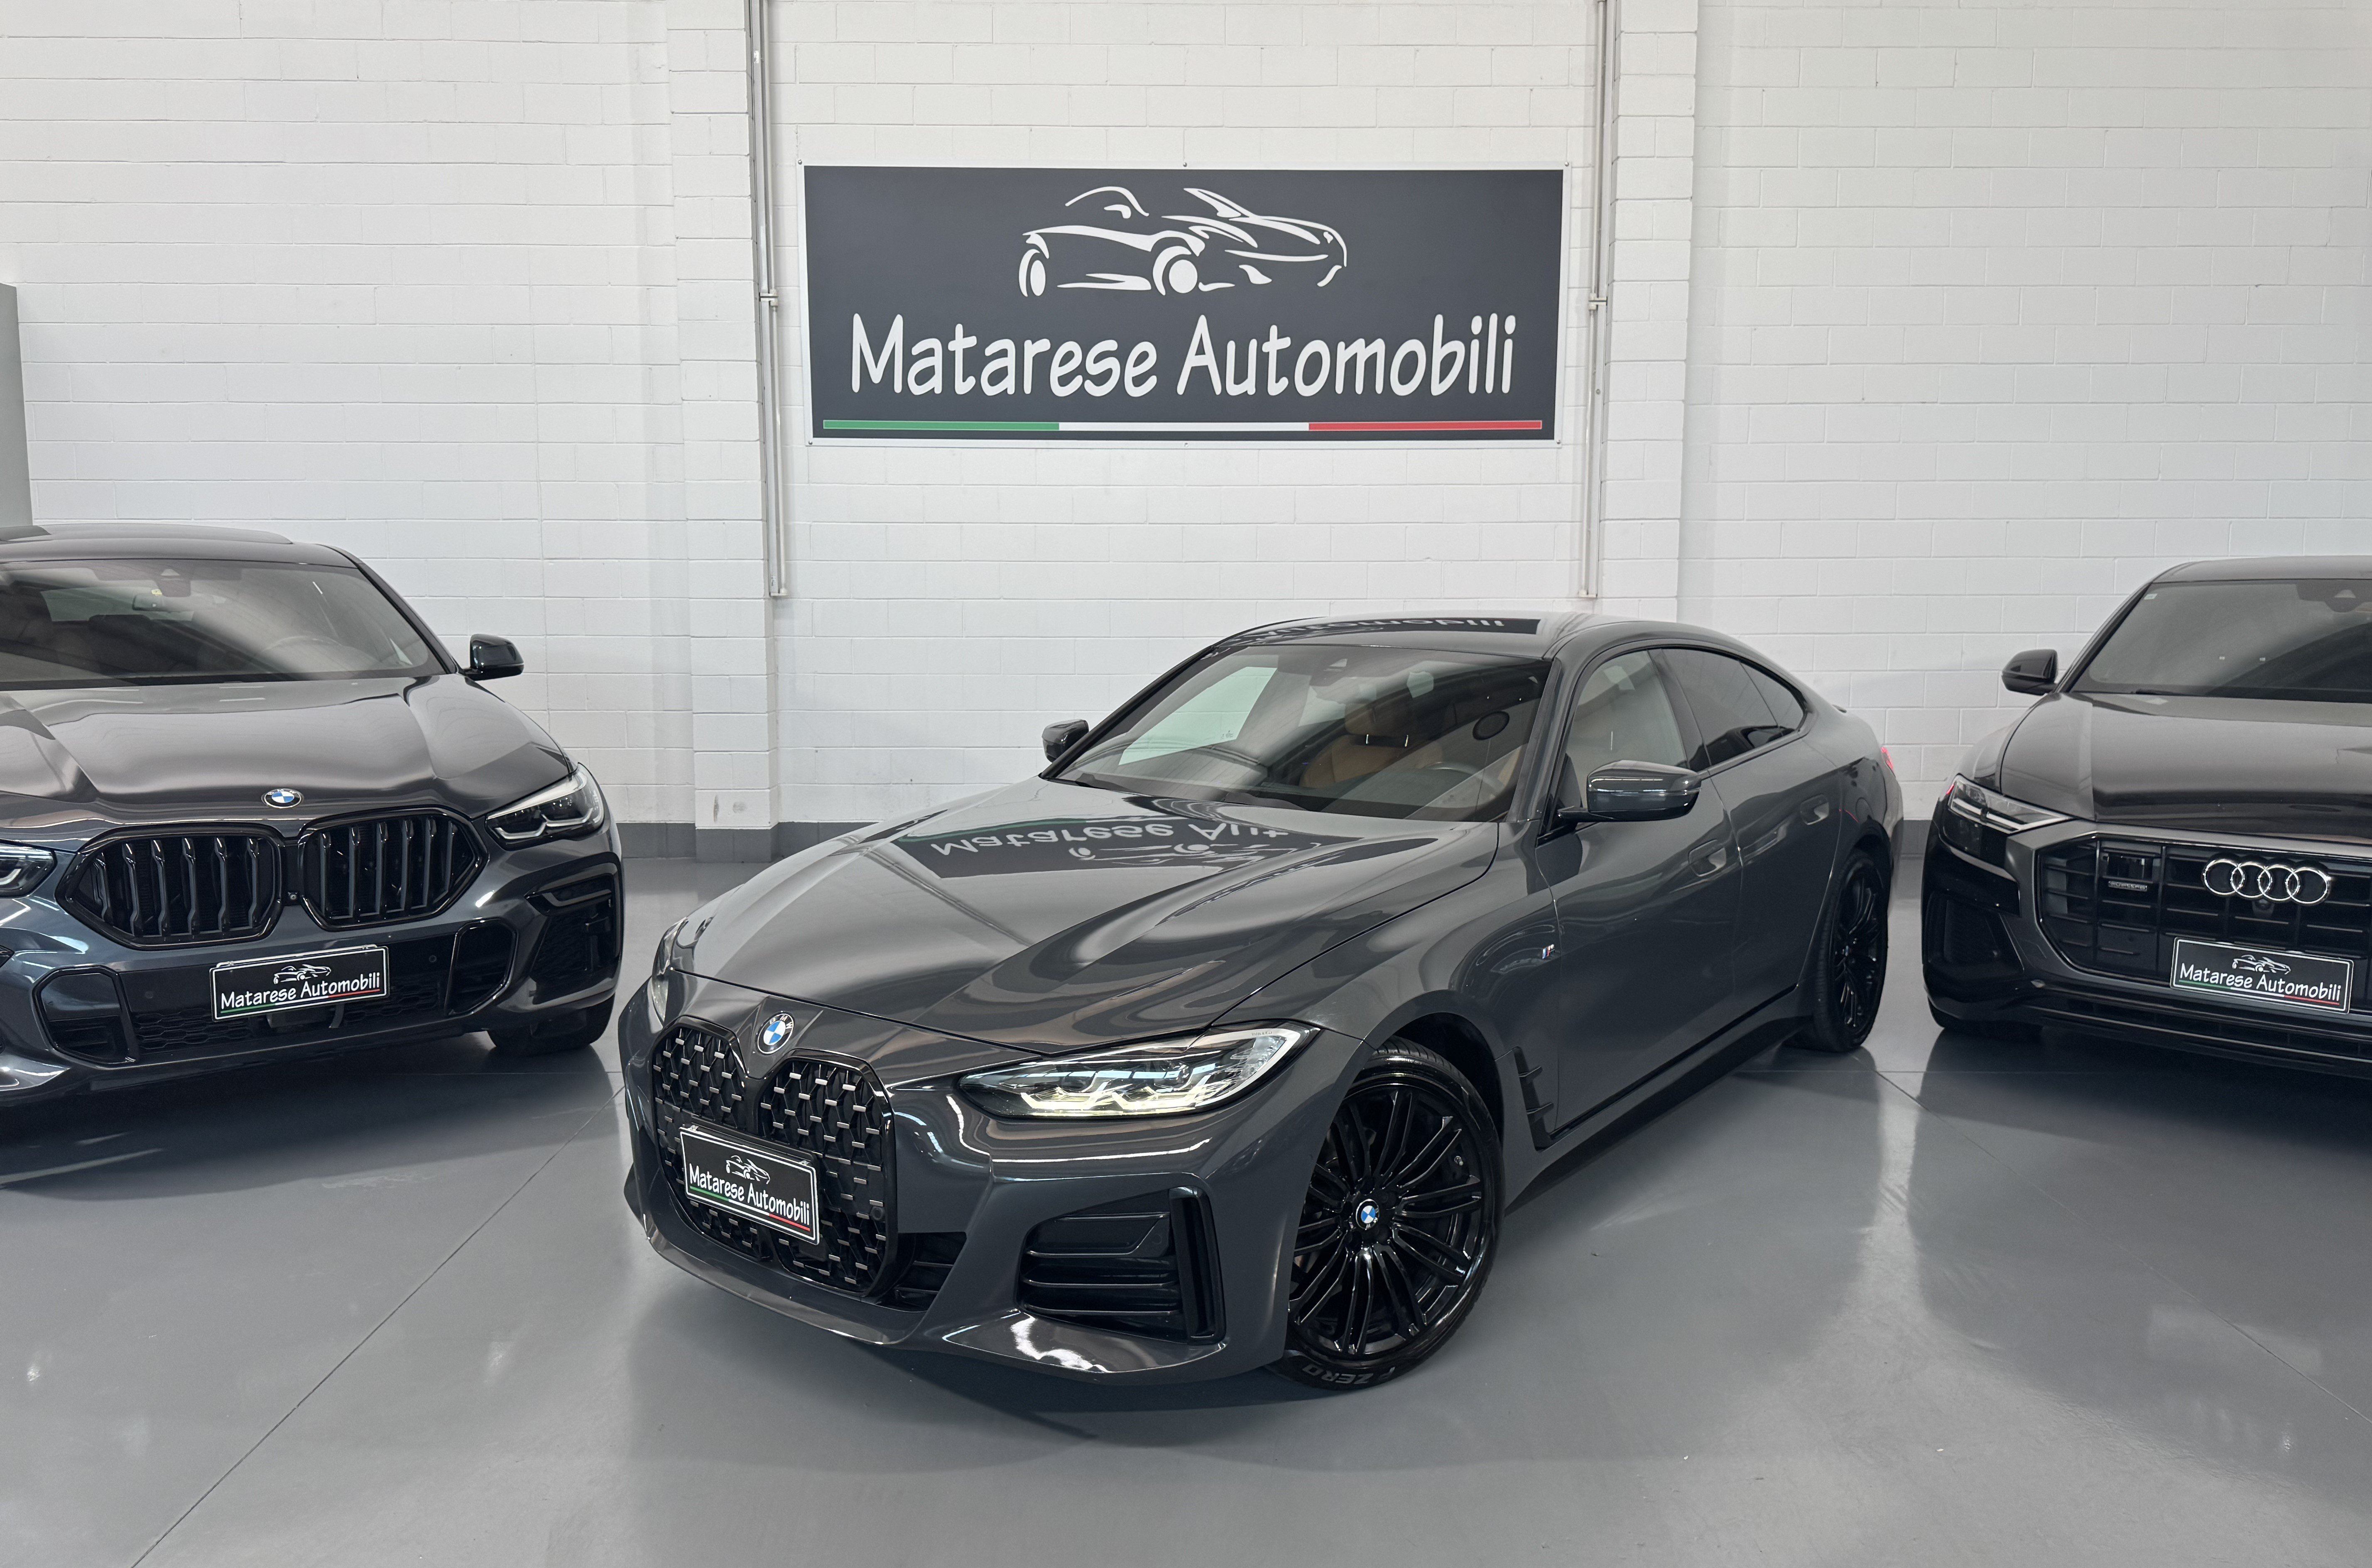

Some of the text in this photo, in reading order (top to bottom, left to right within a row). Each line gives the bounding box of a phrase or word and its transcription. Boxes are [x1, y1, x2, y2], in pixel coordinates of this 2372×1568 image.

[852, 313, 1516, 397] Matarese Automobili
[221, 972, 380, 1010] Matarese Automobili
[2180, 963, 2341, 1001] Matarese Automobili
[689, 1163, 810, 1226] Matarese Automobili
[1302, 1364, 1374, 1384] ZERO
